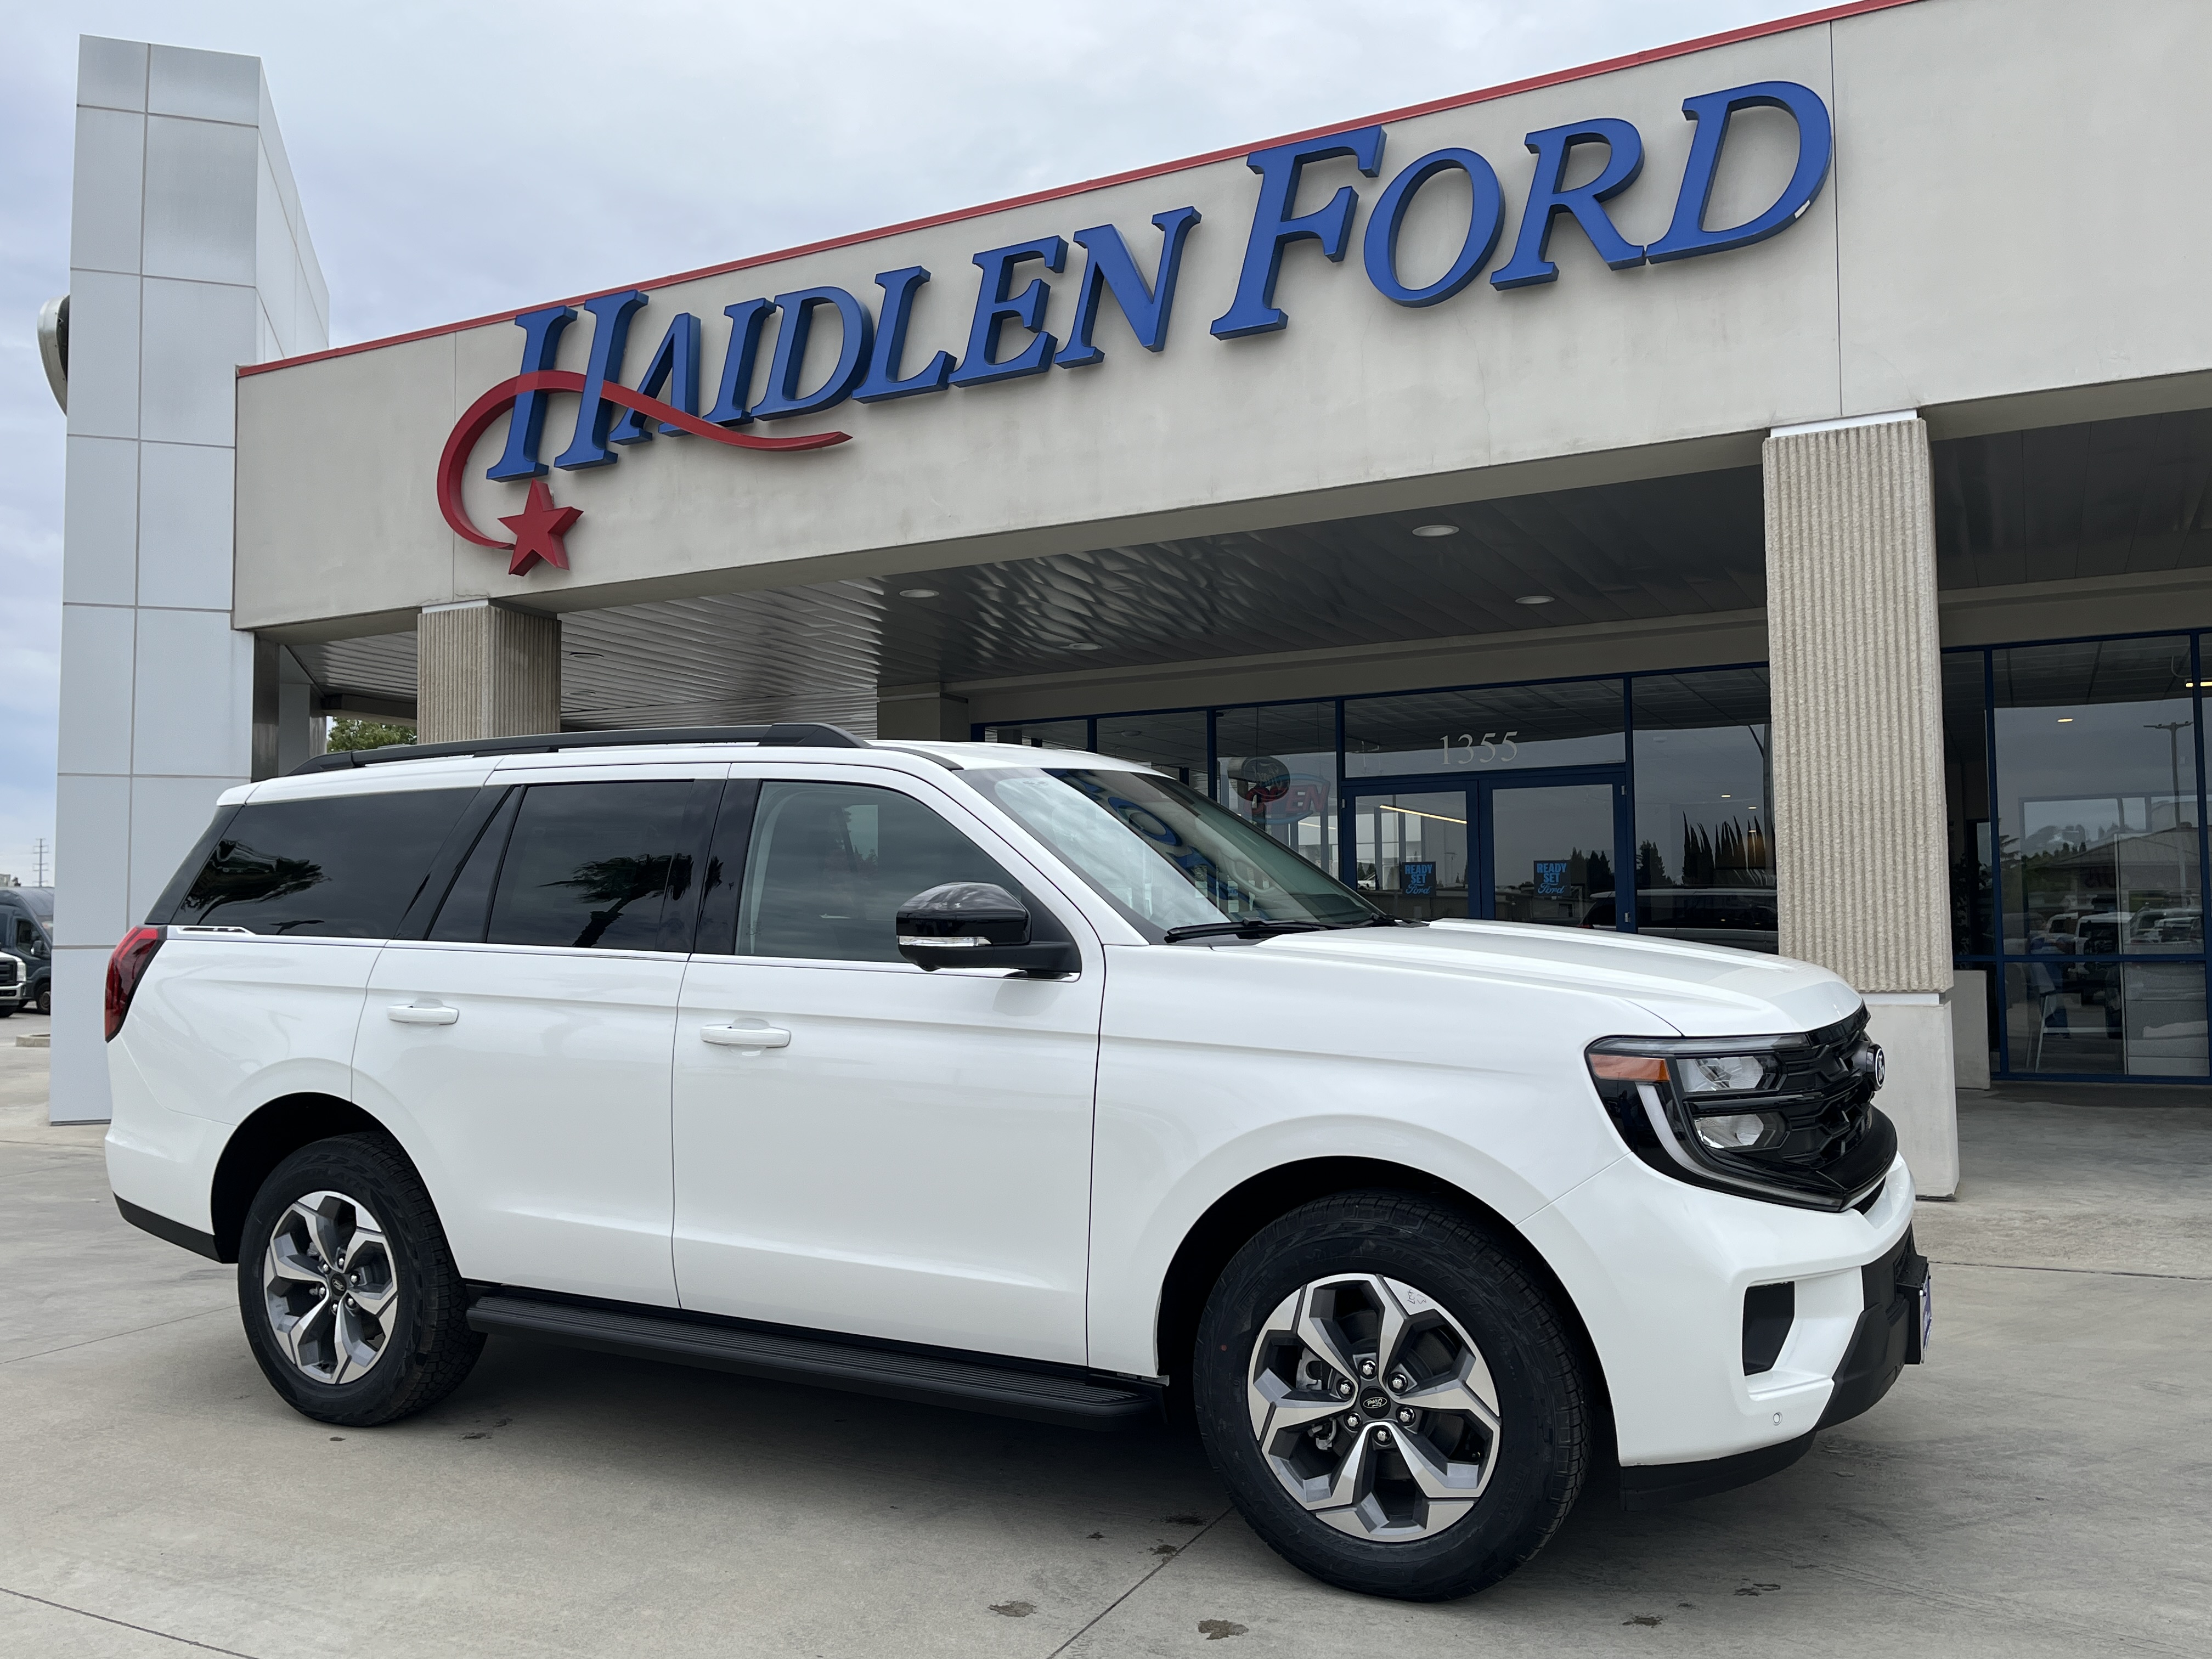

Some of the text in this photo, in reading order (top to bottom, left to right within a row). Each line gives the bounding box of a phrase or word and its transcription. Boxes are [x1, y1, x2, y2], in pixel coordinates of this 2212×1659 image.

[486, 81, 1832, 482] HAIDLEN FORD
[1440, 731, 1518, 765] 1355
[1243, 782, 1330, 815] OPEN
[1405, 865, 1432, 874] READY
[1537, 863, 1567, 873] READY
[1411, 874, 1426, 884] SET
[1543, 873, 1560, 883] SET
[1406, 884, 1432, 894] Ford
[1538, 883, 1567, 894] Ford
[1372, 1244, 1485, 1312] PIRELLI
